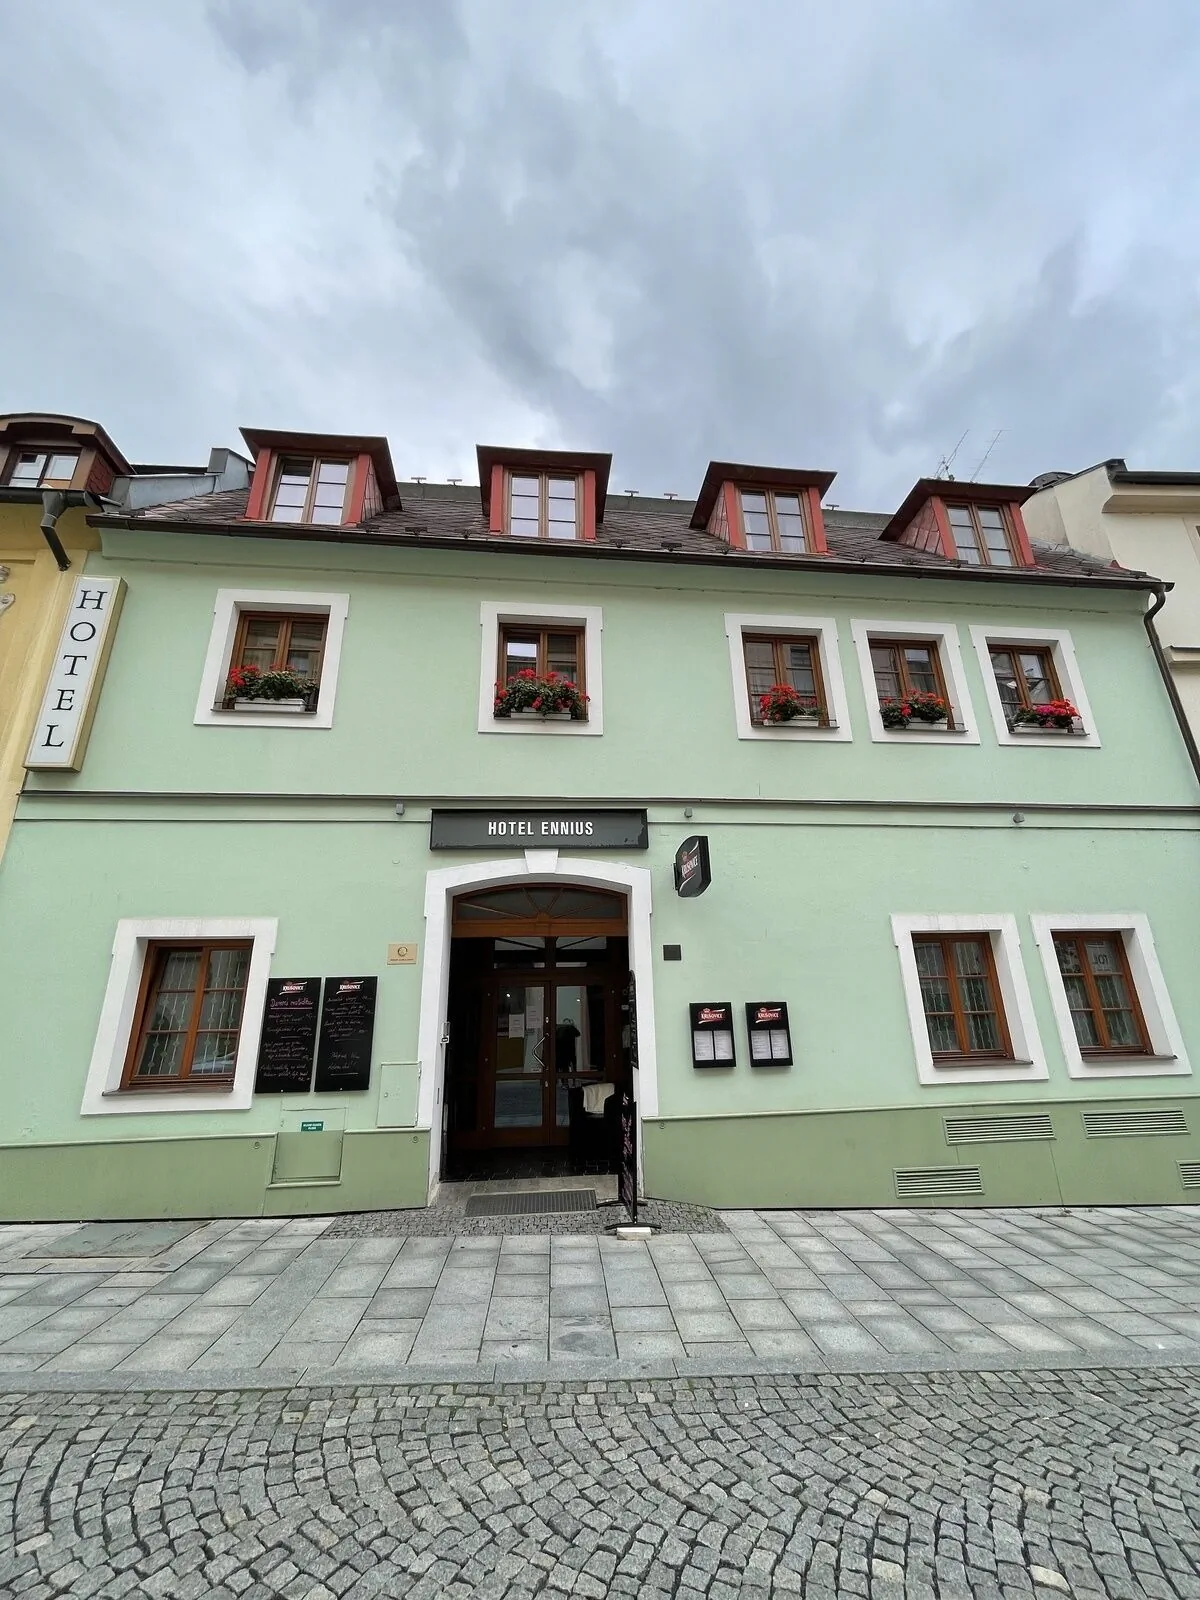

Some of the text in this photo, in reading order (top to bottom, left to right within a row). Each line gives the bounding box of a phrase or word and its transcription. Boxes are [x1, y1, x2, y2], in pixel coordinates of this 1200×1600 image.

[41, 590, 108, 747] HOTEL
[488, 821, 594, 836] HOTEL ENNIUS
